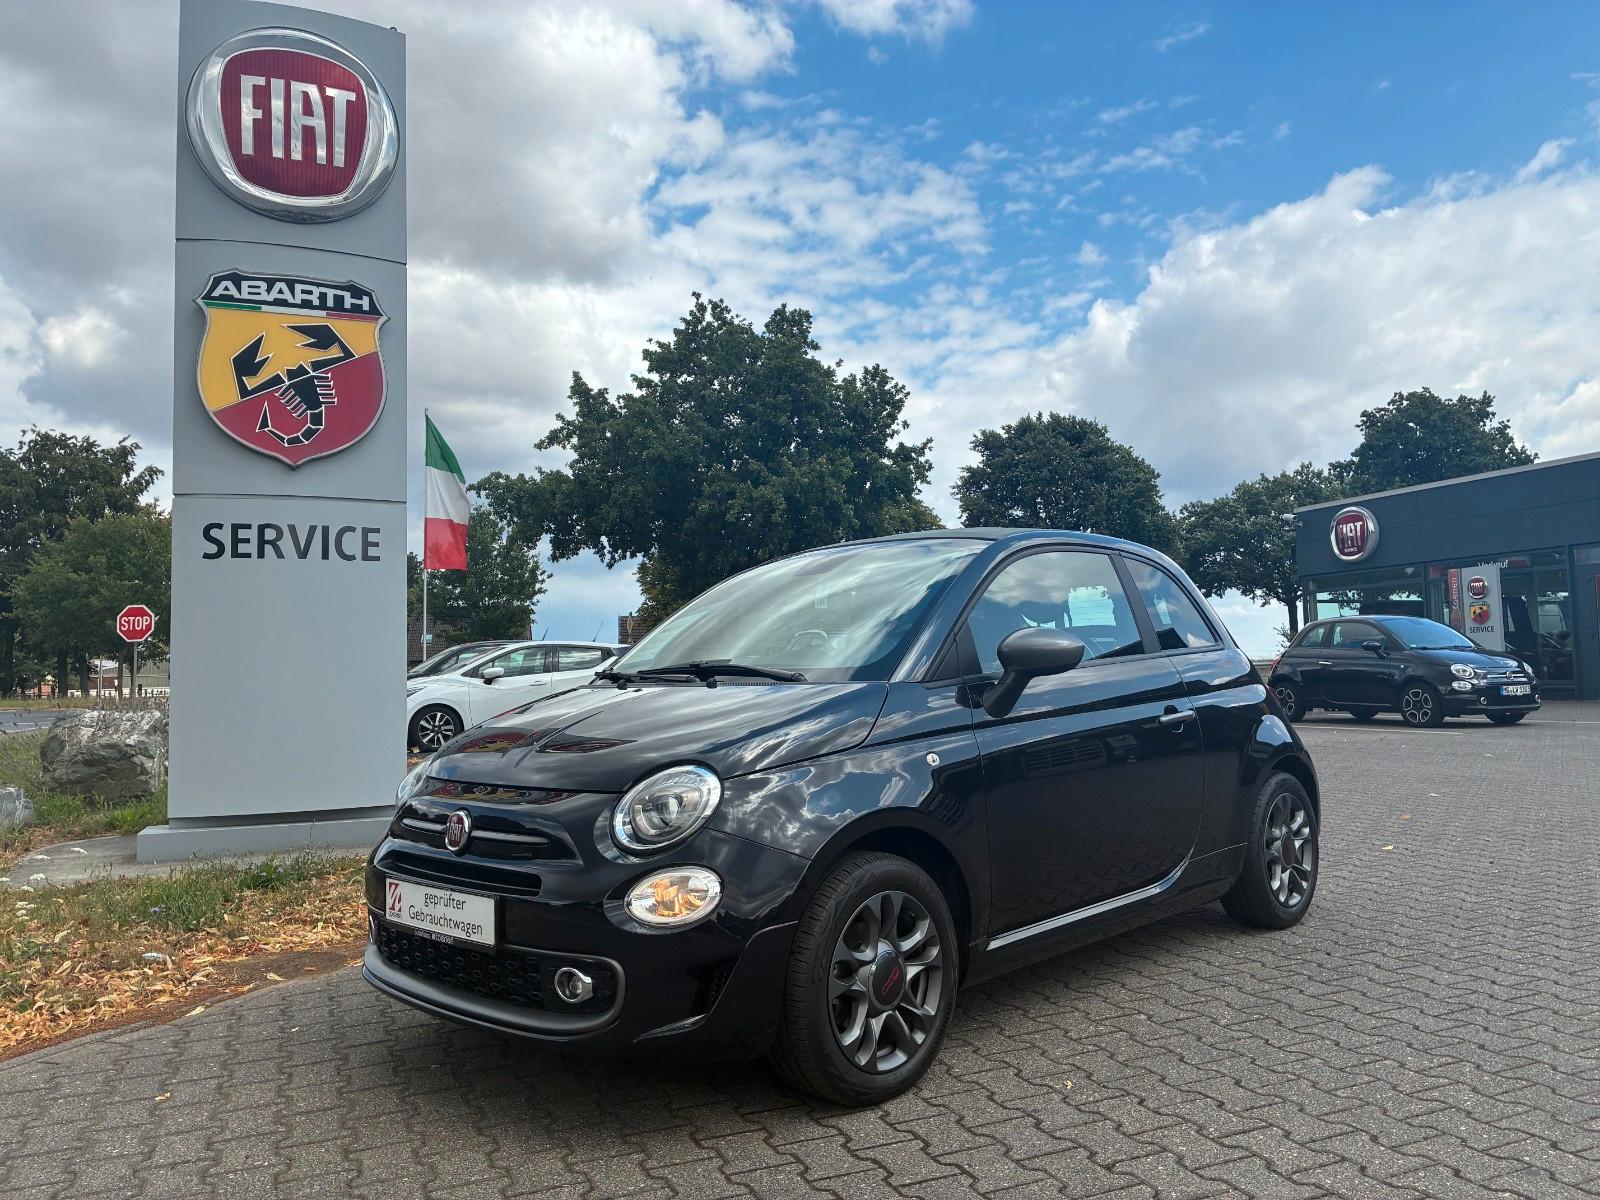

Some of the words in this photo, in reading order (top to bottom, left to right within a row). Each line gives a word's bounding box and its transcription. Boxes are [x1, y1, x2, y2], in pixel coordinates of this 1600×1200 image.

[240, 74, 357, 168] FIAT
[210, 280, 370, 311] ABARTH
[202, 522, 381, 562] SERVICE
[1337, 521, 1363, 549] FIAT
[121, 616, 151, 631] STOP
[1469, 625, 1495, 634] SERVICE
[424, 893, 467, 910] geprüfter
[408, 904, 483, 938] Gebrauchtwagen
